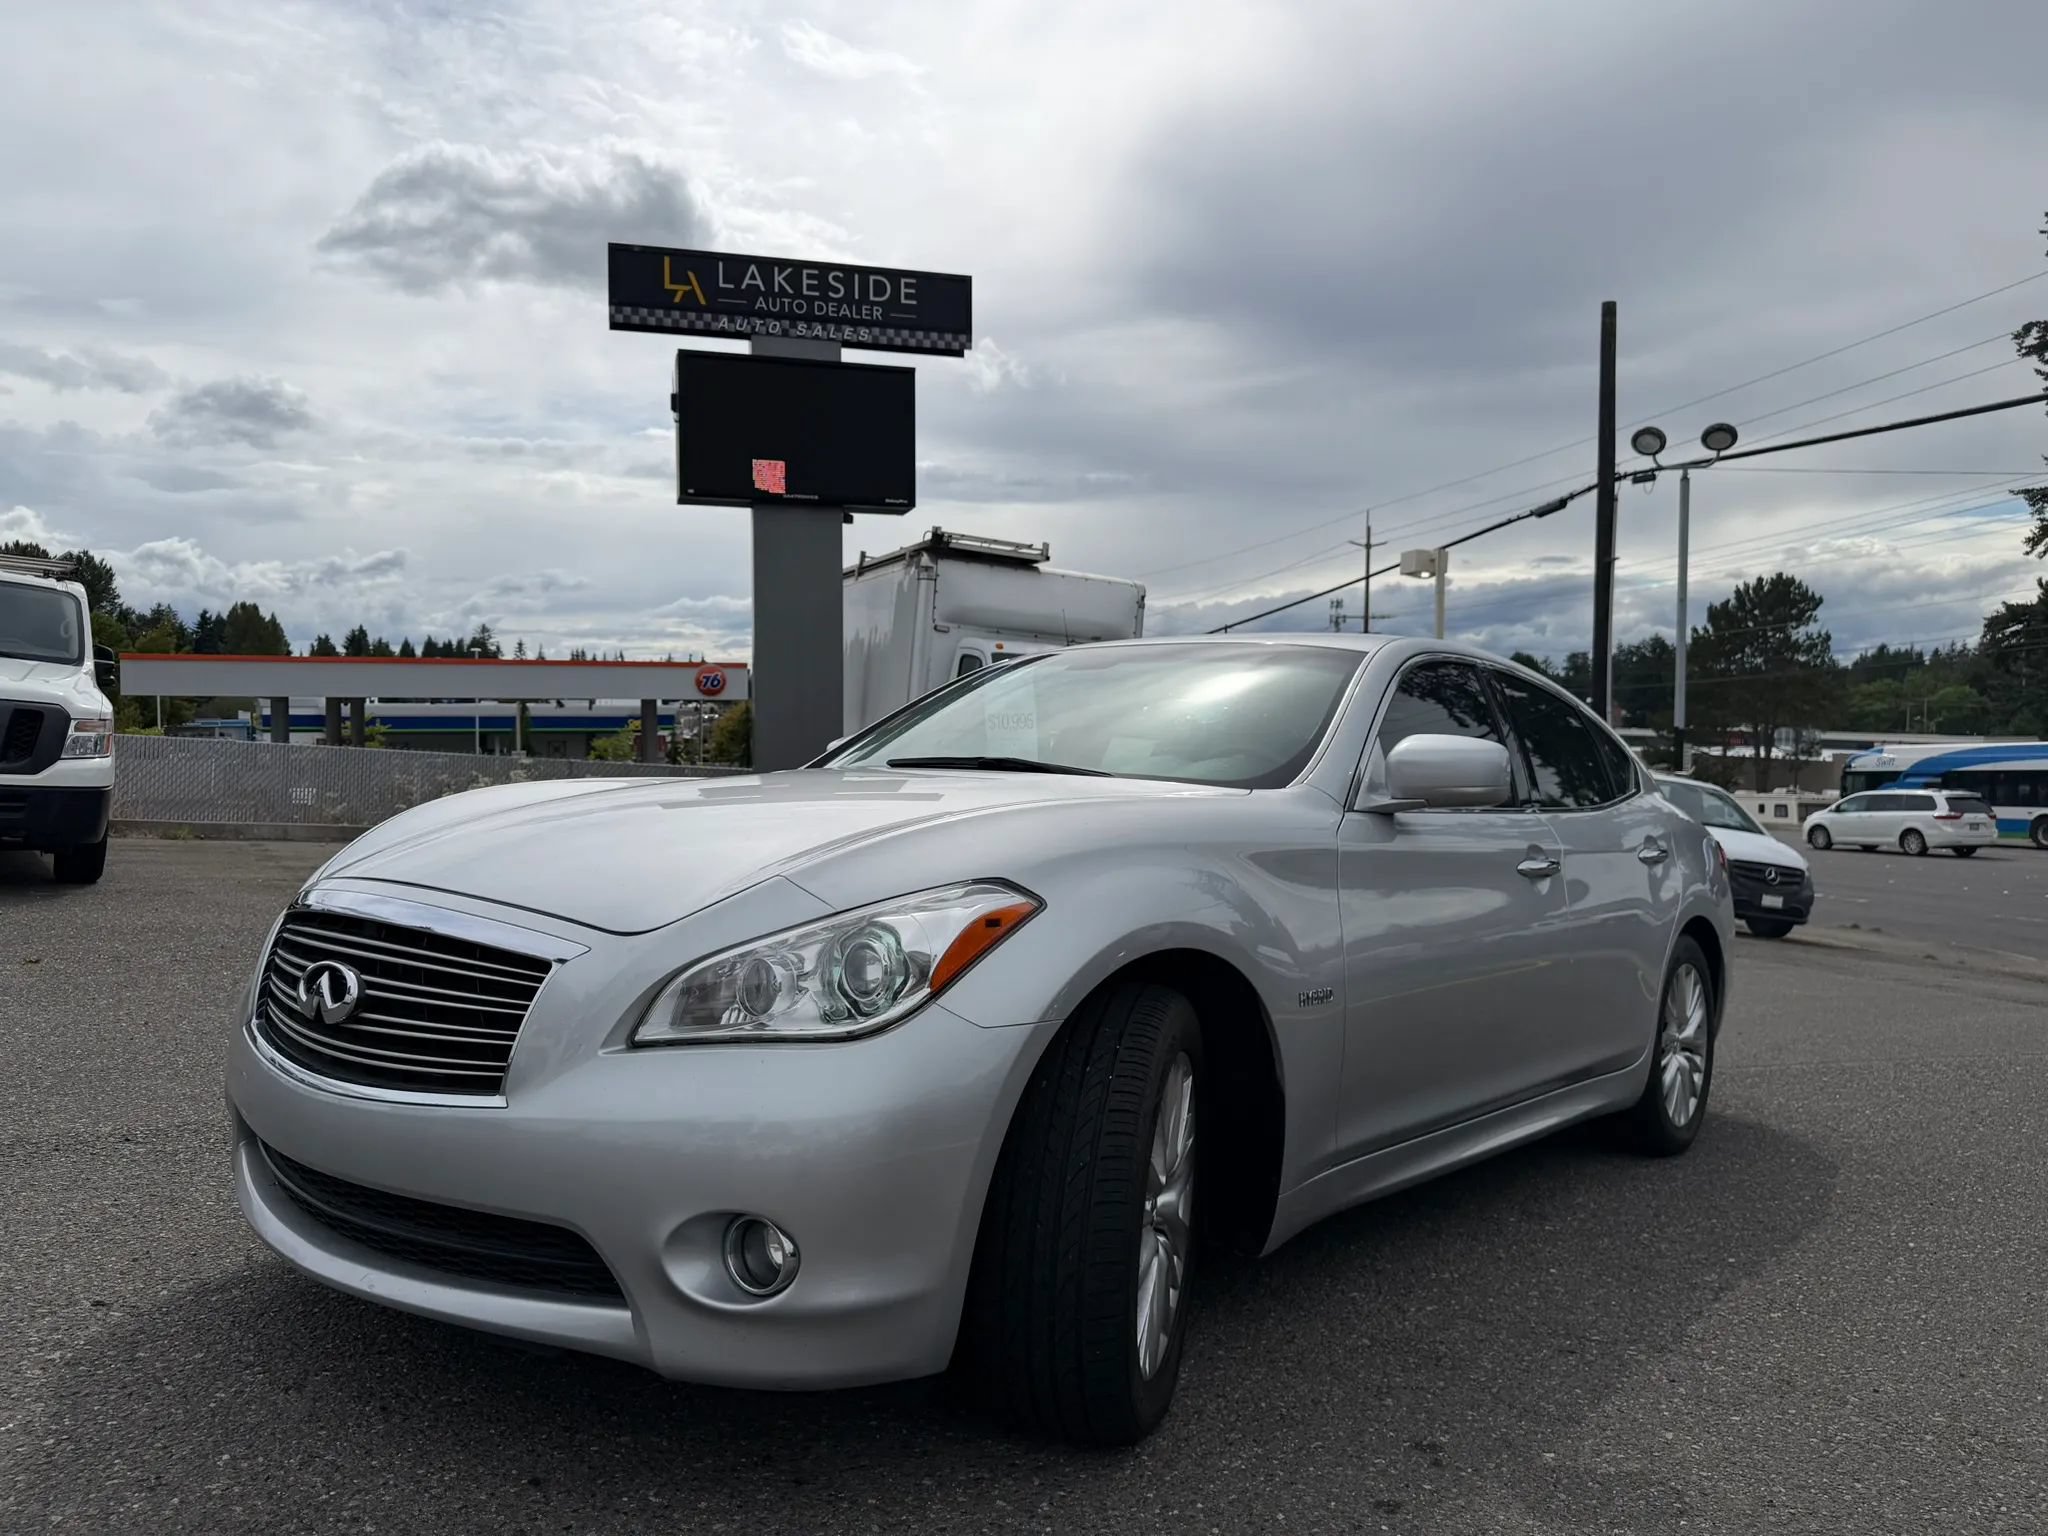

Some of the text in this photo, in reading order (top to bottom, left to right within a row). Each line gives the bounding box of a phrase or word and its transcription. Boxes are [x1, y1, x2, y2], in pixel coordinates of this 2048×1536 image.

[664, 256, 706, 305] LA
[718, 260, 917, 304] LAKESIDE
[754, 296, 883, 320] AUTO DEALER
[718, 317, 870, 341] AUTO SALES
[702, 673, 721, 689] 76
